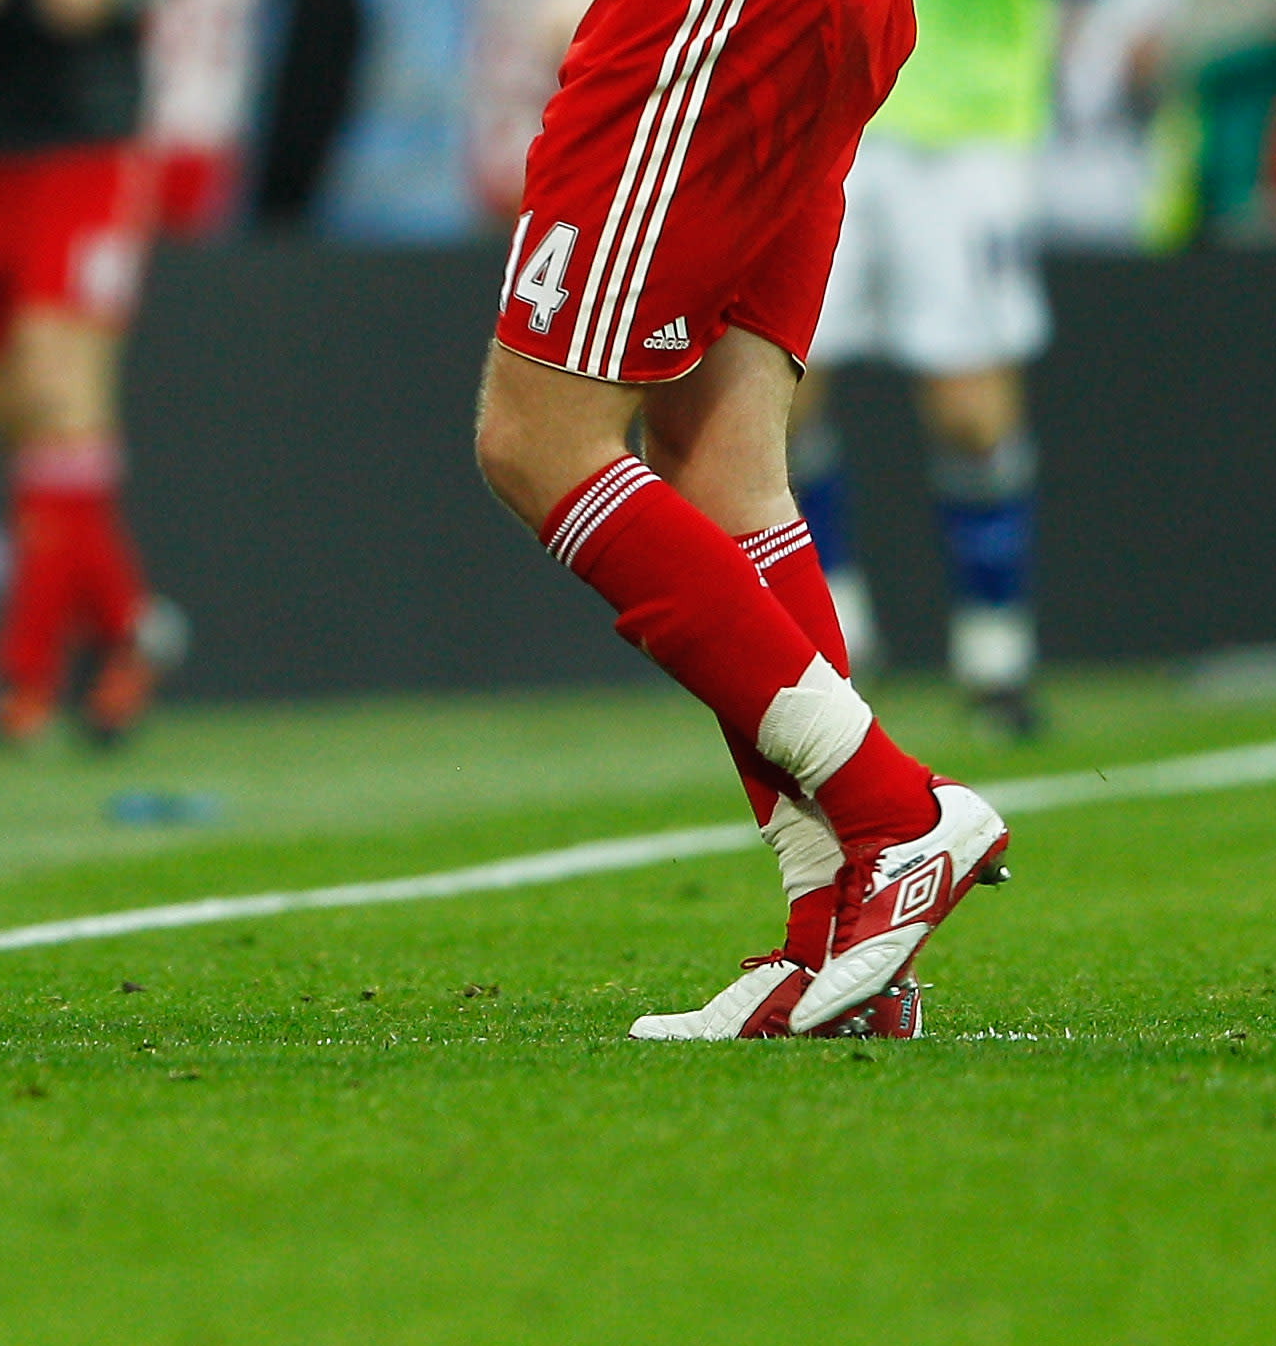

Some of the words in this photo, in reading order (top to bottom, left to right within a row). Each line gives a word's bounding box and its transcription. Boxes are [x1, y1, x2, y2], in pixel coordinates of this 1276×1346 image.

[499, 210, 580, 335] 14
[643, 336, 690, 350] adidas
[900, 991, 914, 1030] umb
